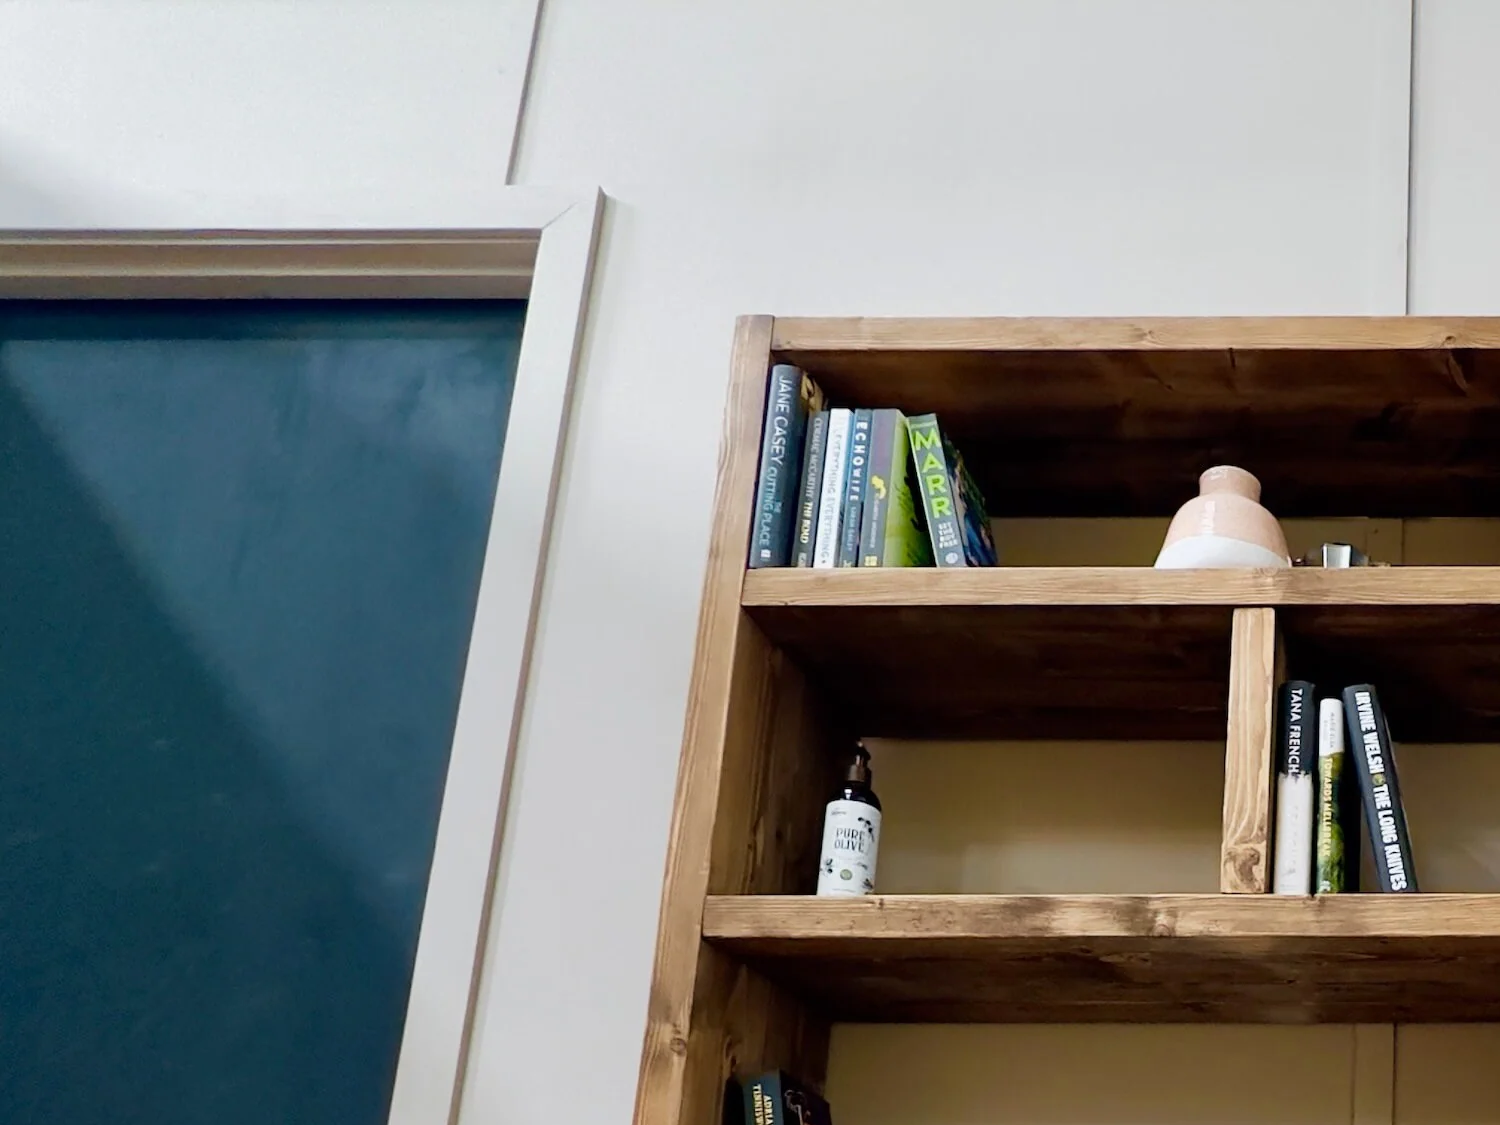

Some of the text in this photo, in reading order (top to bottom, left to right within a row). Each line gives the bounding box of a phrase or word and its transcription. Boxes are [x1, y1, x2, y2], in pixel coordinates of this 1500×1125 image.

[770, 376, 793, 464] JANE CASEY
[810, 418, 823, 453] CORMAC
[759, 467, 778, 546] CUTTING PLACE
[803, 501, 813, 518] THE
[821, 434, 842, 558] EVERYTHING EVERYTHING
[914, 430, 952, 518] MARR
[800, 519, 811, 543] ROAD
[1288, 689, 1303, 773] TANA FRENCH
[1322, 758, 1332, 856] TOWARDS MELLBREAK
[1355, 692, 1407, 891] IRVINE WELSH THE LONG KNIVES
[835, 839, 865, 853] OLIVE
[836, 828, 865, 841] PURE
